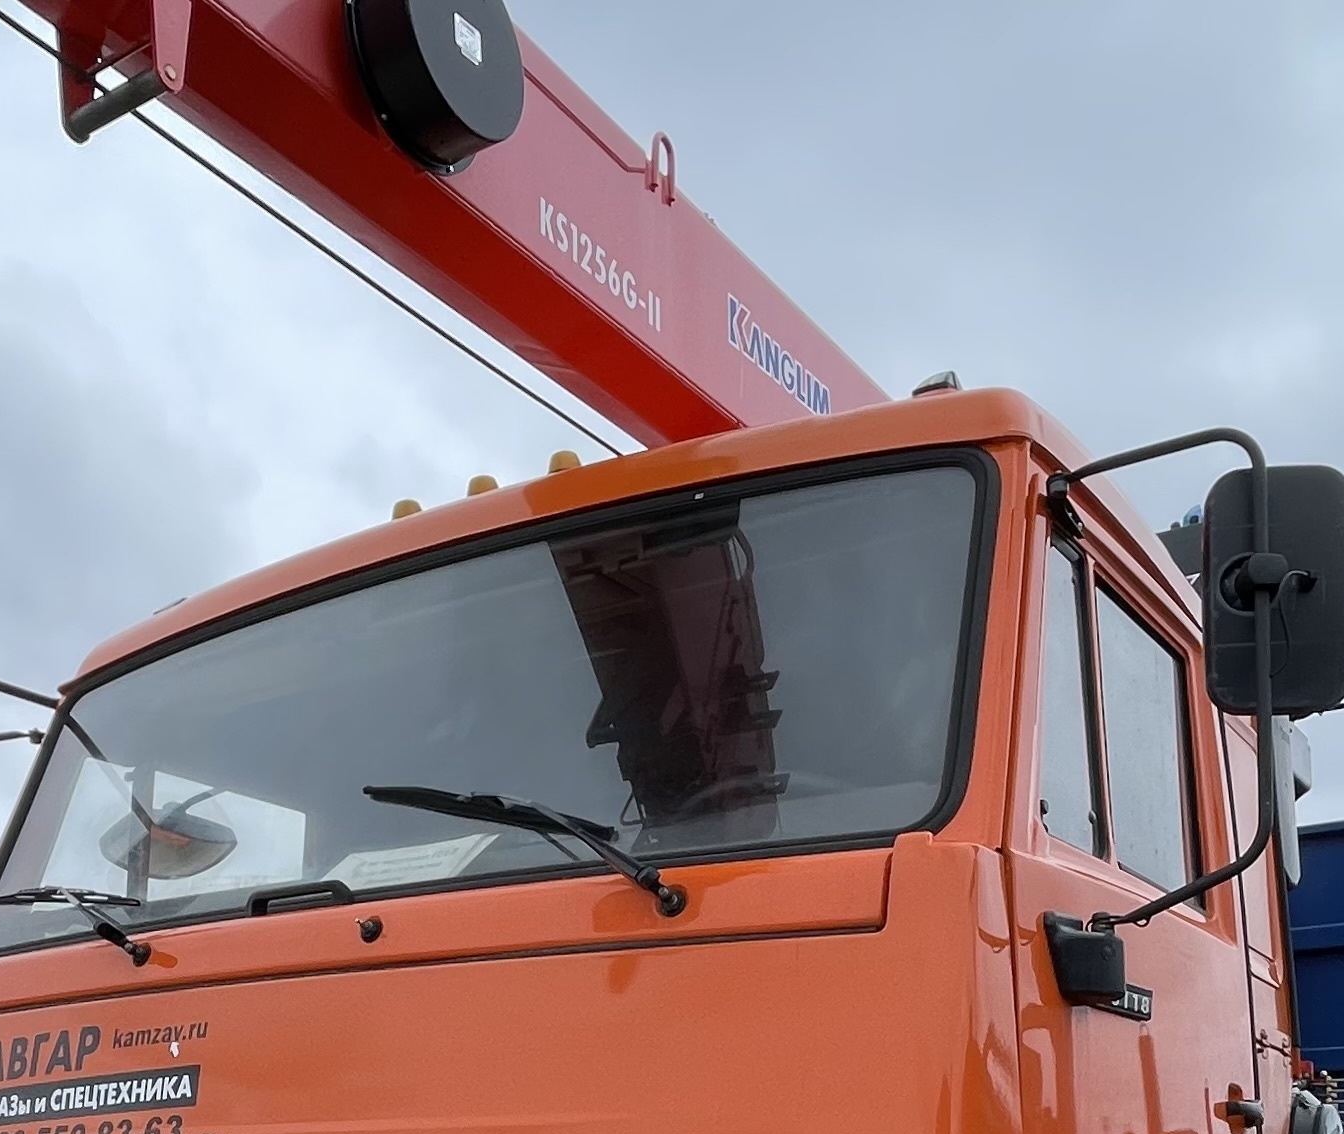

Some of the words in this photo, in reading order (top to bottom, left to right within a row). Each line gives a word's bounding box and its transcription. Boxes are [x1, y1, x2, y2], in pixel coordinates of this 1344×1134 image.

[727, 292, 831, 416] KANGLIM
[1111, 990, 1150, 1014] 118
[112, 1021, 209, 1049] kamzav.ru
[34, 1097, 47, 1114] и
[50, 1074, 192, 1112] СПЕЦТЕХНИКА
